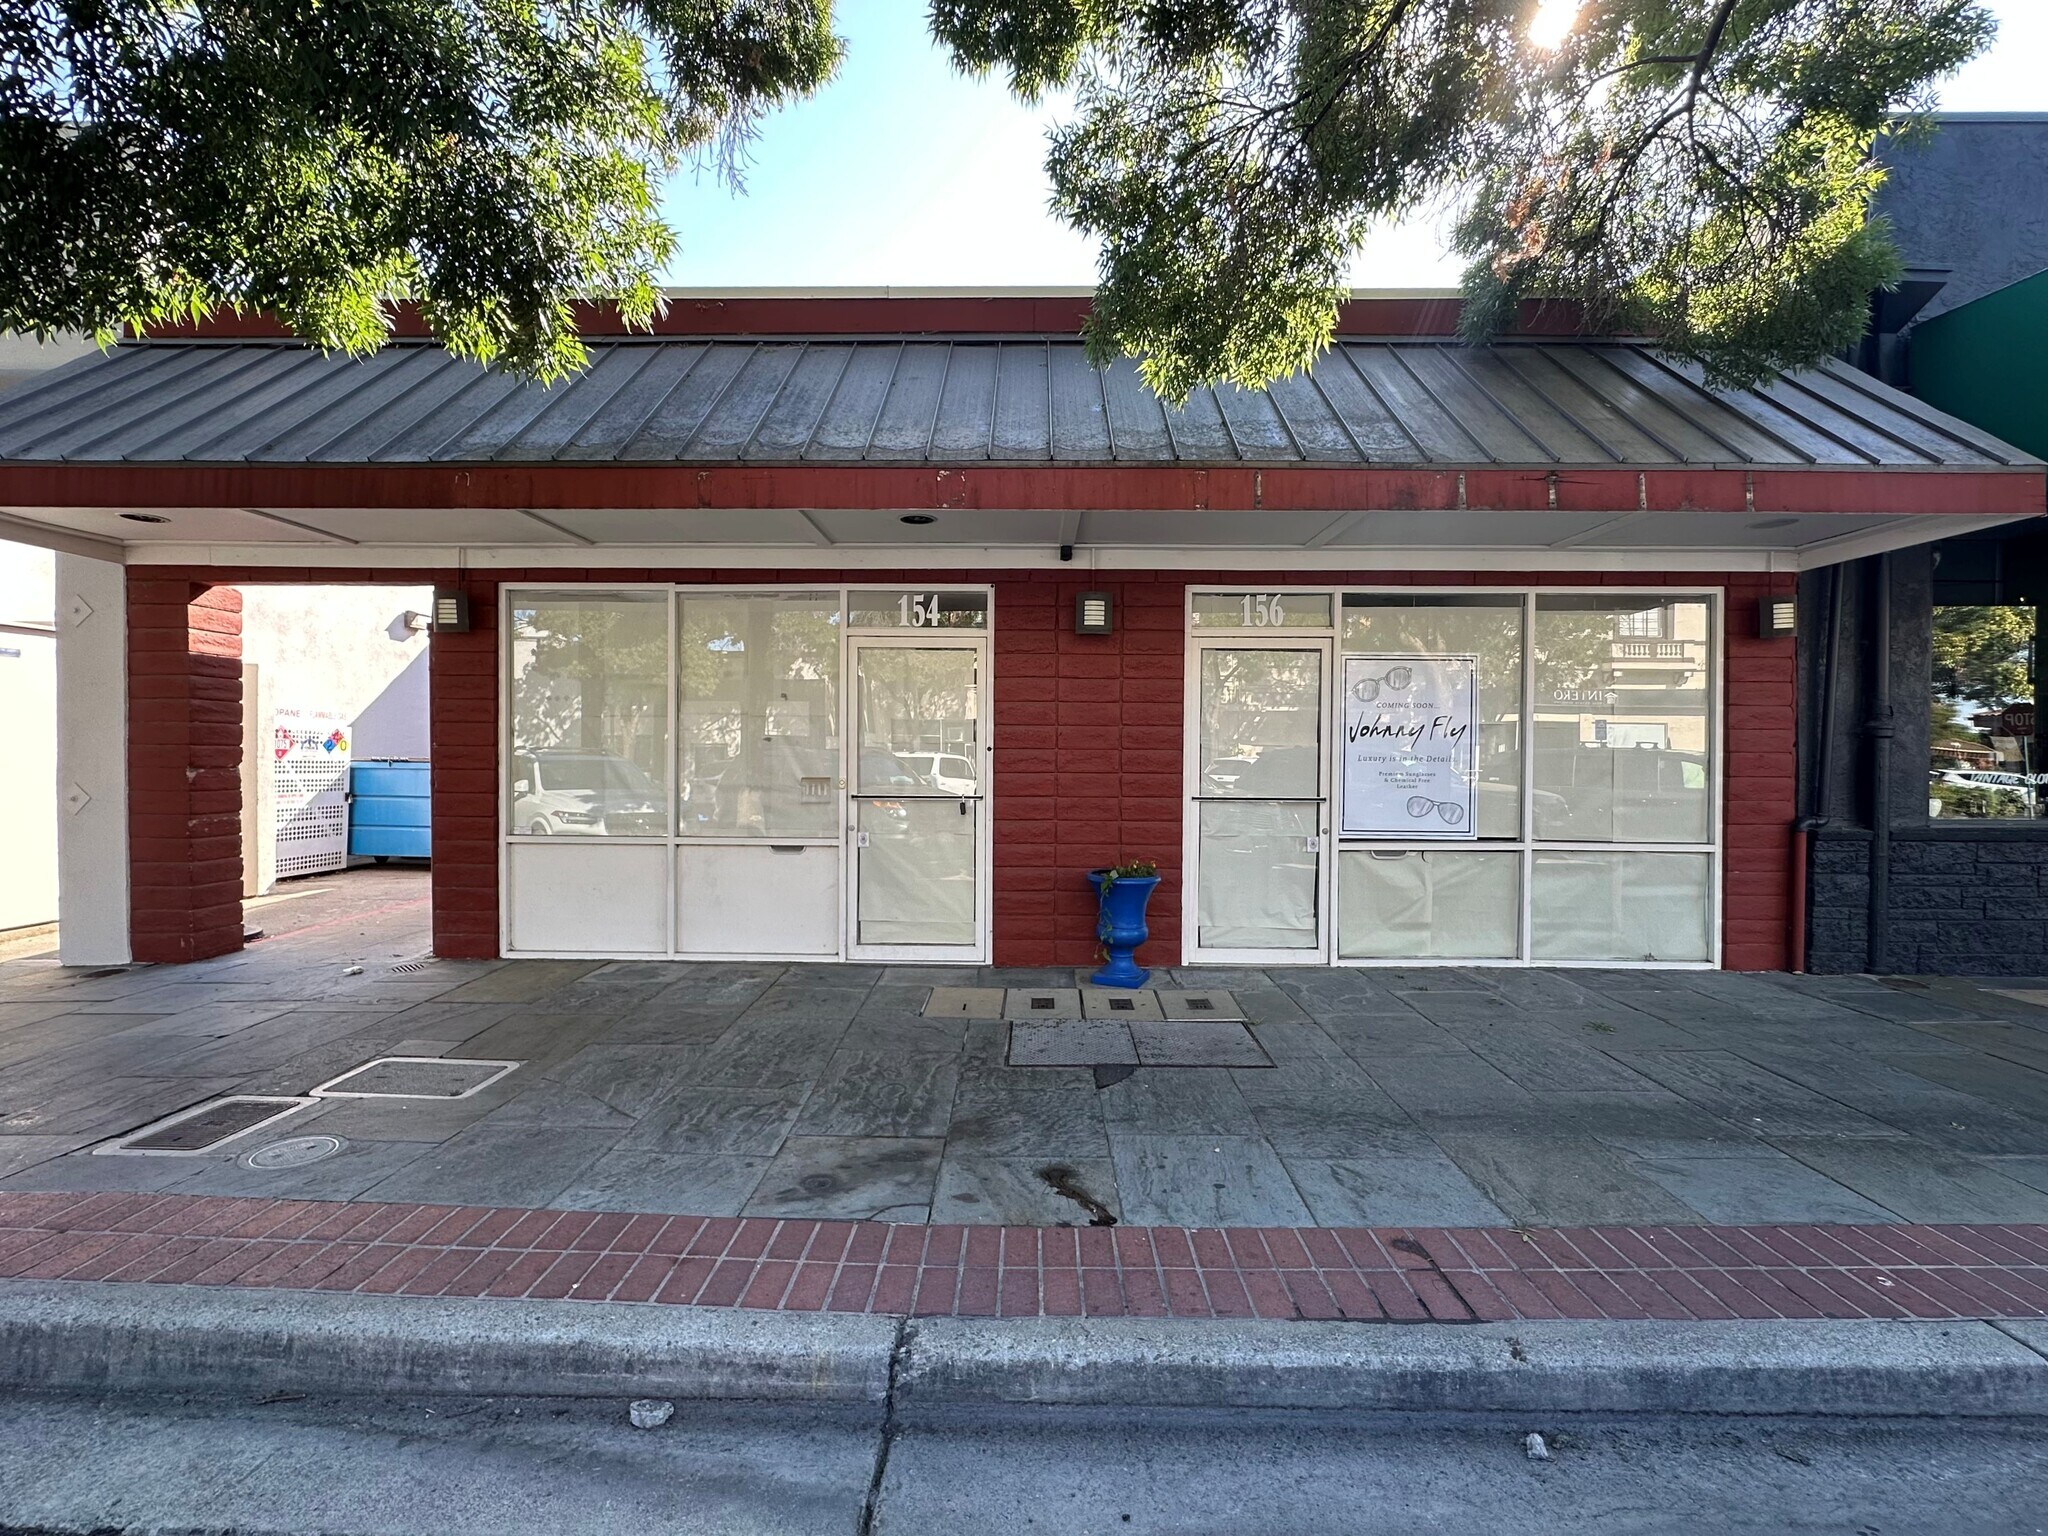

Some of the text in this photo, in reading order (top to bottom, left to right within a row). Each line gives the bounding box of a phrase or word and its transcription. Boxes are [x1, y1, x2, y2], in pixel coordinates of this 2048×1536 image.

[898, 594, 940, 627] 154
[1240, 594, 1284, 627] 156
[1349, 711, 1467, 749] Johnny Fly
[327, 739, 333, 750] 2
[340, 740, 347, 751] 0
[1358, 755, 1387, 763] Luxury
[1411, 754, 1424, 762] the
[1970, 773, 2020, 784] VINTAGE
